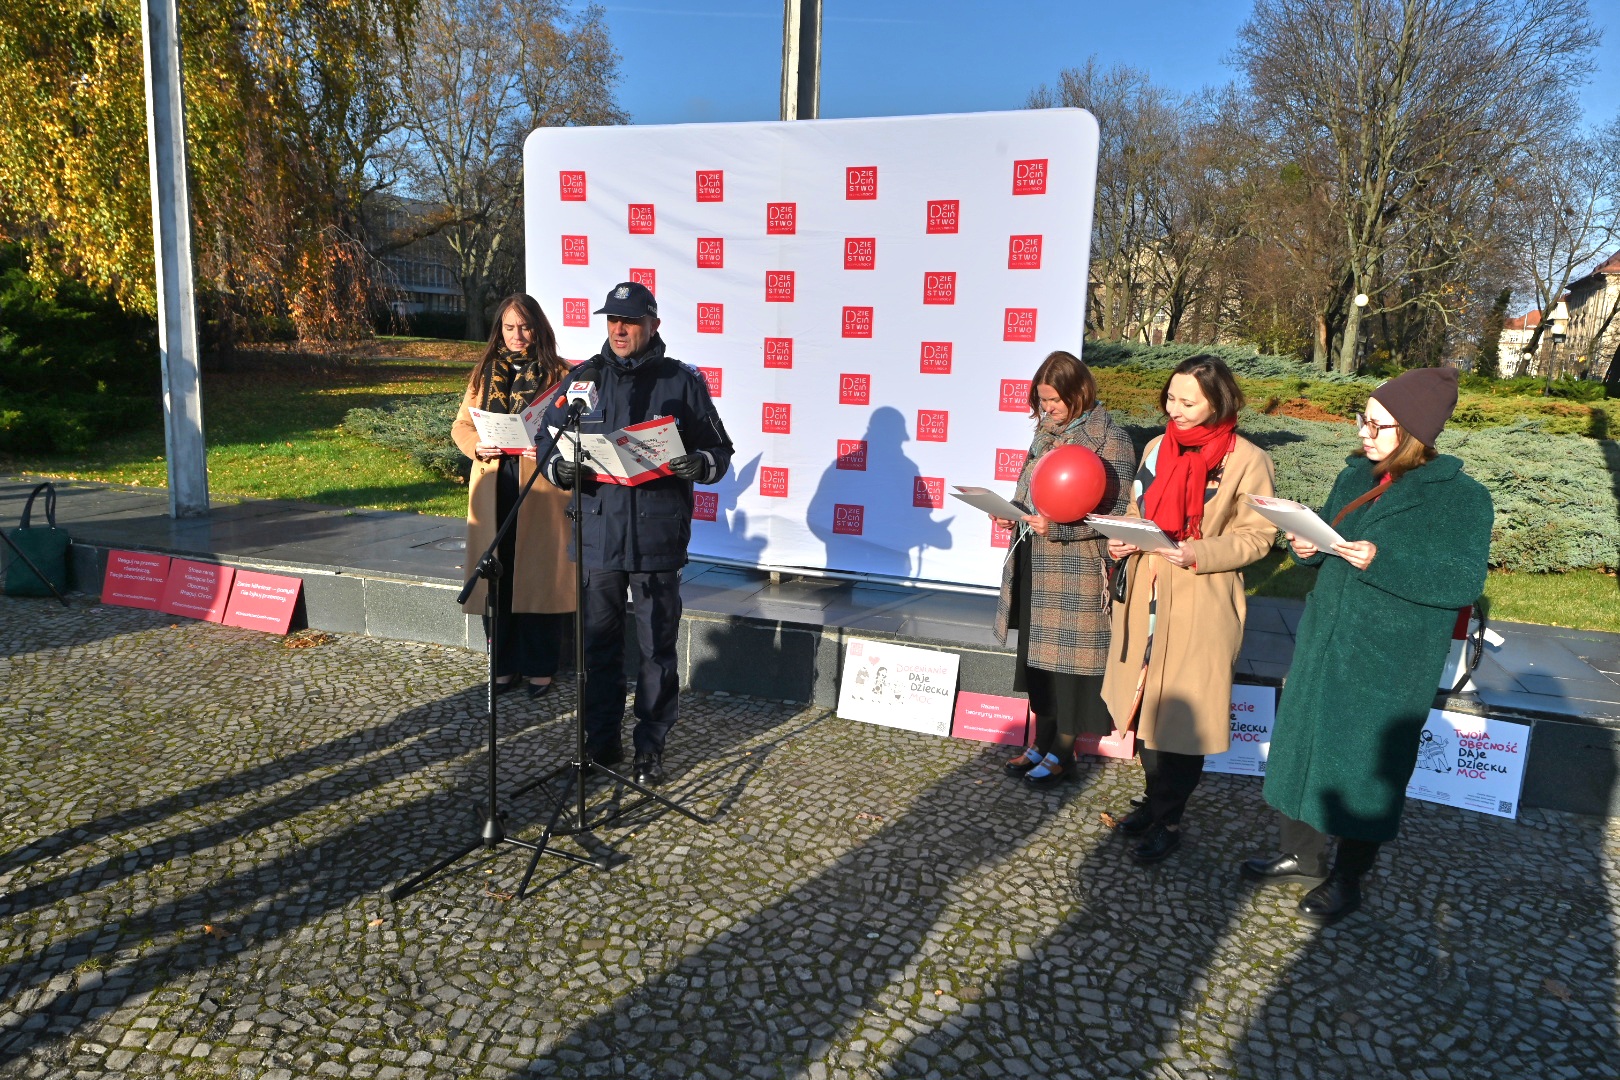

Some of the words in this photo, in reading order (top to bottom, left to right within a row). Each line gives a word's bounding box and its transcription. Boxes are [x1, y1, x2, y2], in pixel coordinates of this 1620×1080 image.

[994, 533, 1010, 541] STW
[909, 693, 933, 704] MOC
[1230, 722, 1267, 733] ziecku
[1232, 733, 1260, 742] MOC
[1456, 769, 1486, 779] MOC
